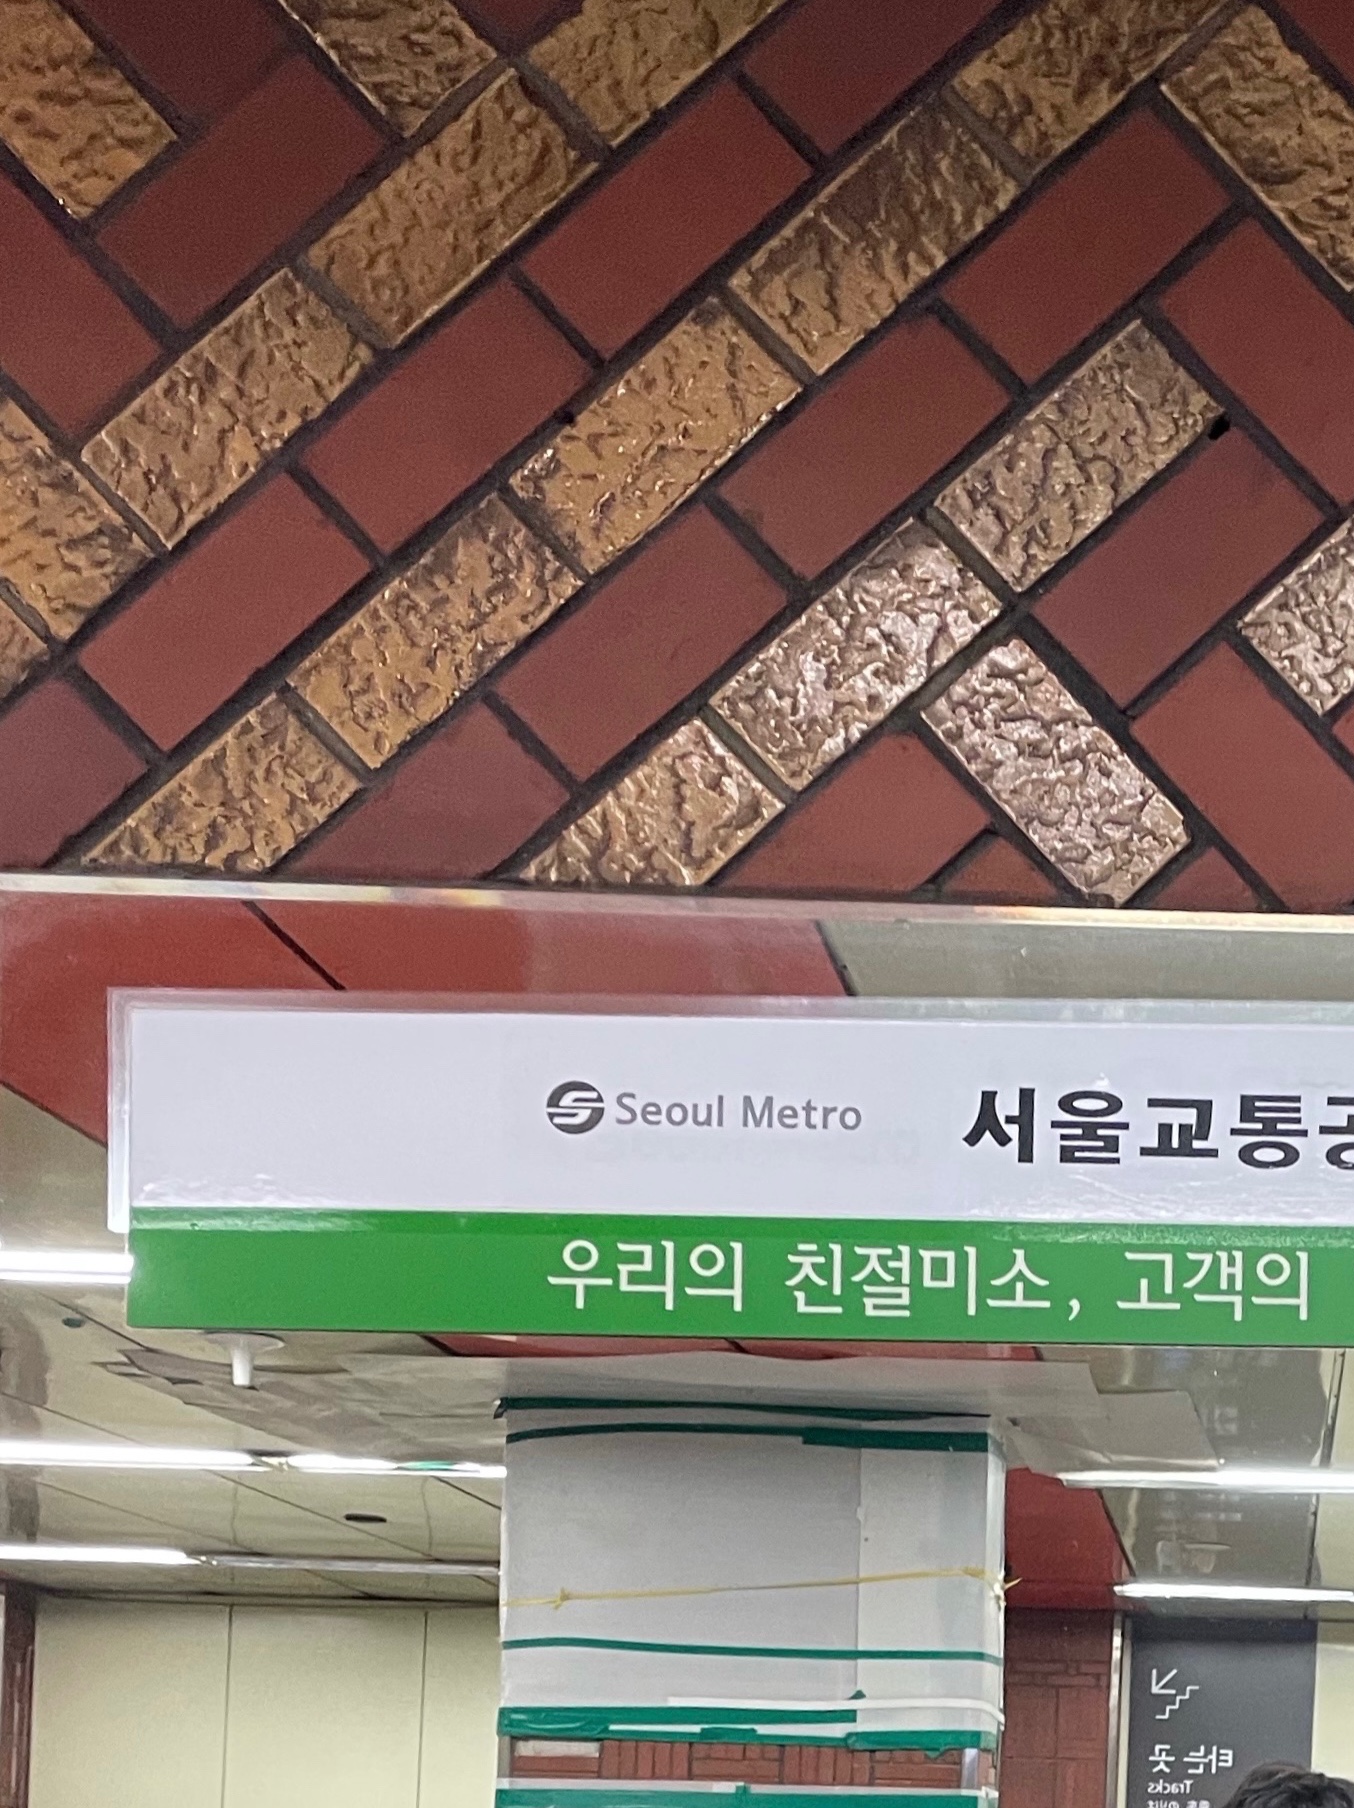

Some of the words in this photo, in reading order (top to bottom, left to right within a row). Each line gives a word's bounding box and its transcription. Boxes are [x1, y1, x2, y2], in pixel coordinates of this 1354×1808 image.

[616, 1092, 724, 1129] Seoul
[742, 1094, 863, 1132] Metro
[547, 1239, 743, 1312] 우리의
[786, 1244, 1081, 1322] 친절미소,
[1116, 1249, 1309, 1322] 고객의
